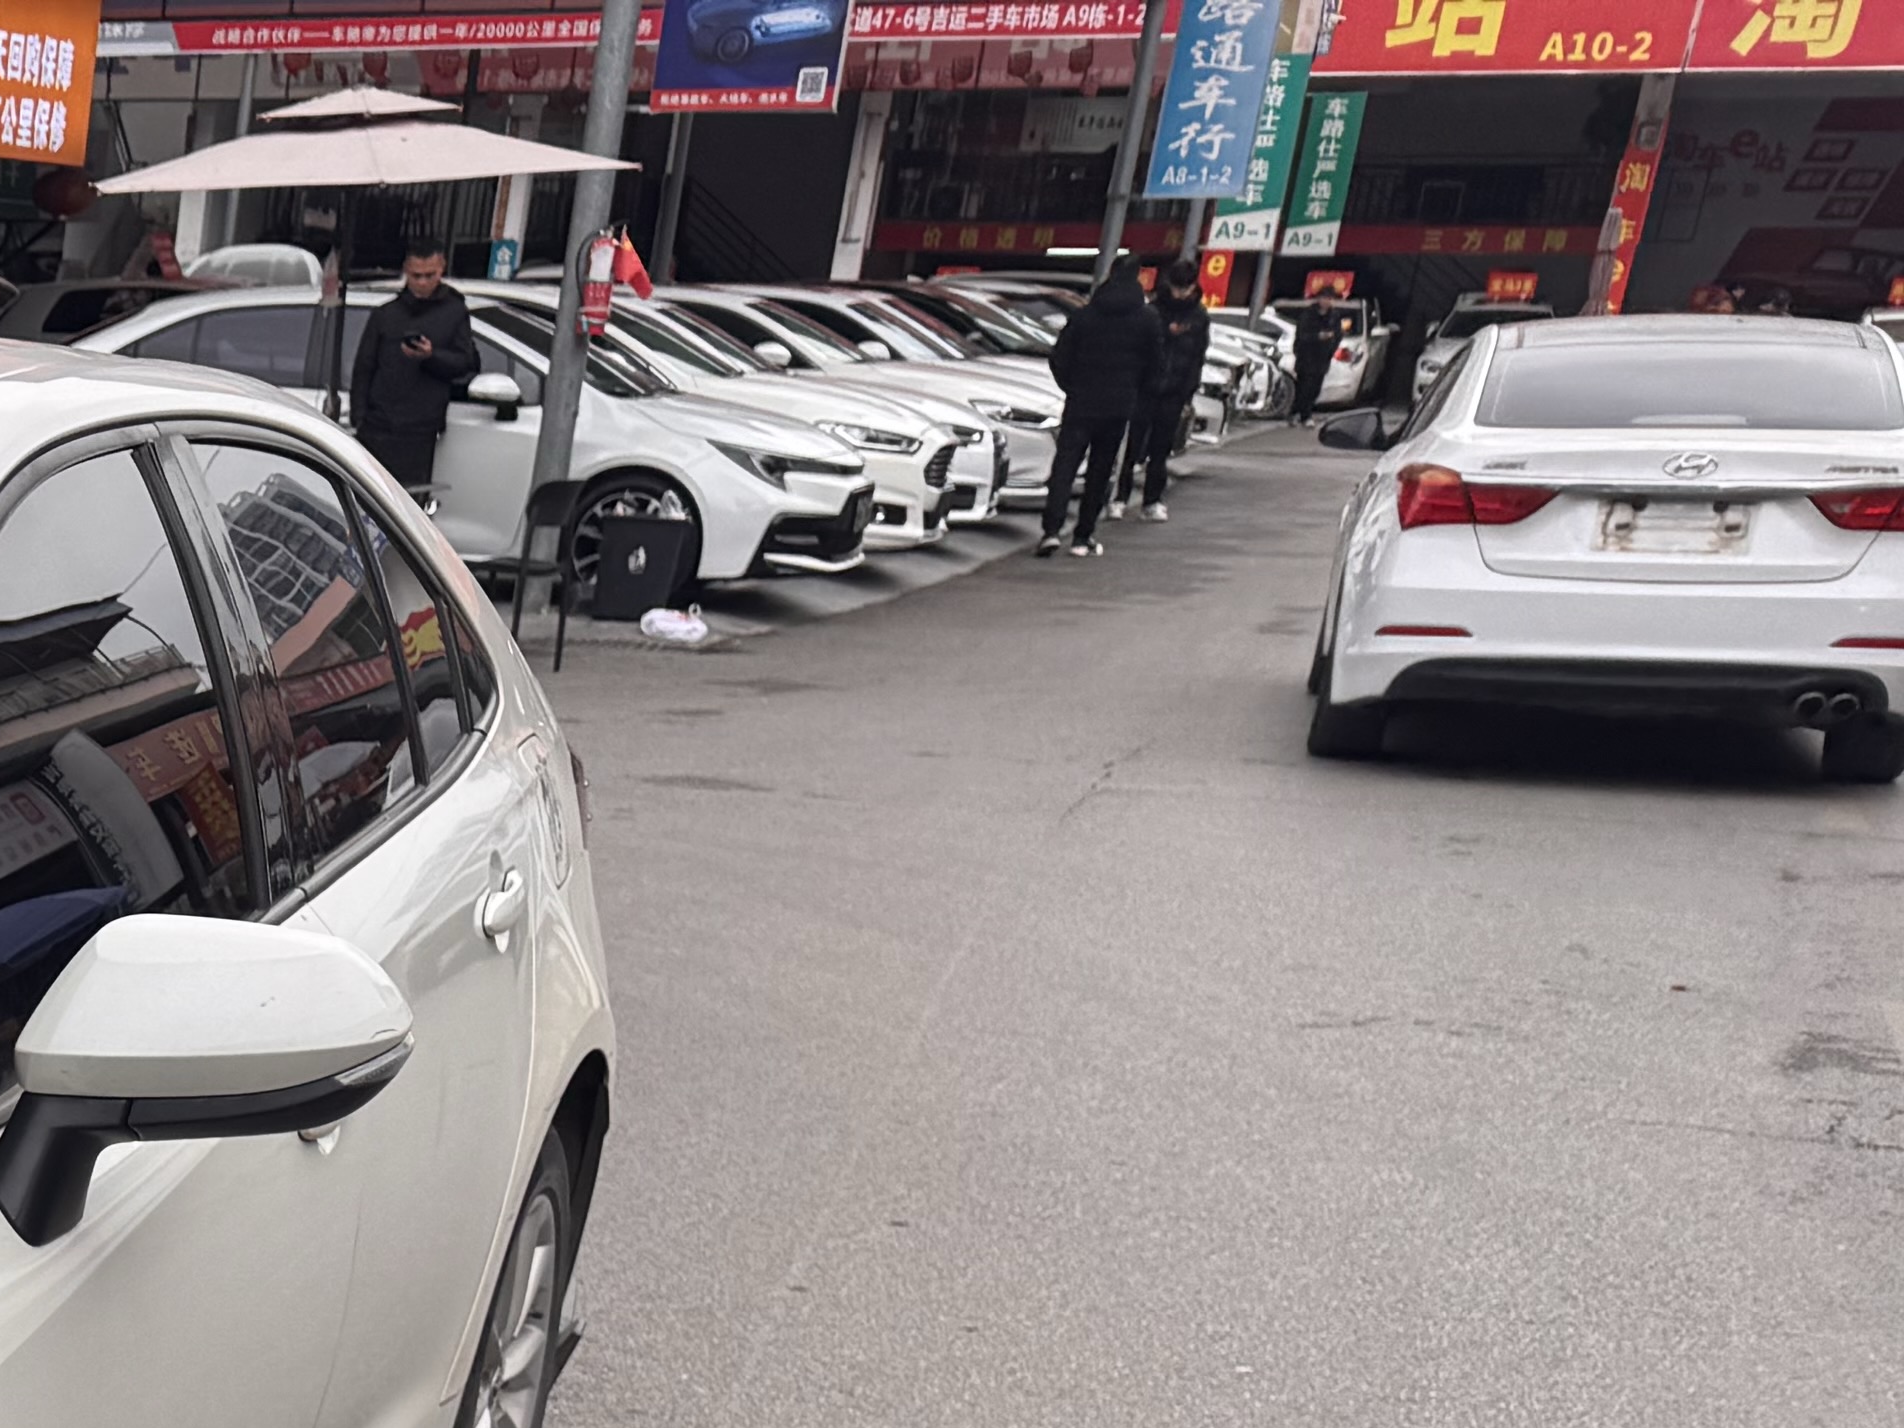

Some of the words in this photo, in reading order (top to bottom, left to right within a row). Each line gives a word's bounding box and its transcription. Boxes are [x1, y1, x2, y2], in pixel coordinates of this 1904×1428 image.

[849, 4, 1060, 32] 道47-6号吉运二手车市场
[1539, 31, 1653, 62] A10-2
[1161, 166, 1233, 186] A8-1-2
[1215, 221, 1272, 241] A9-1
[1287, 232, 1334, 248] A9-1
